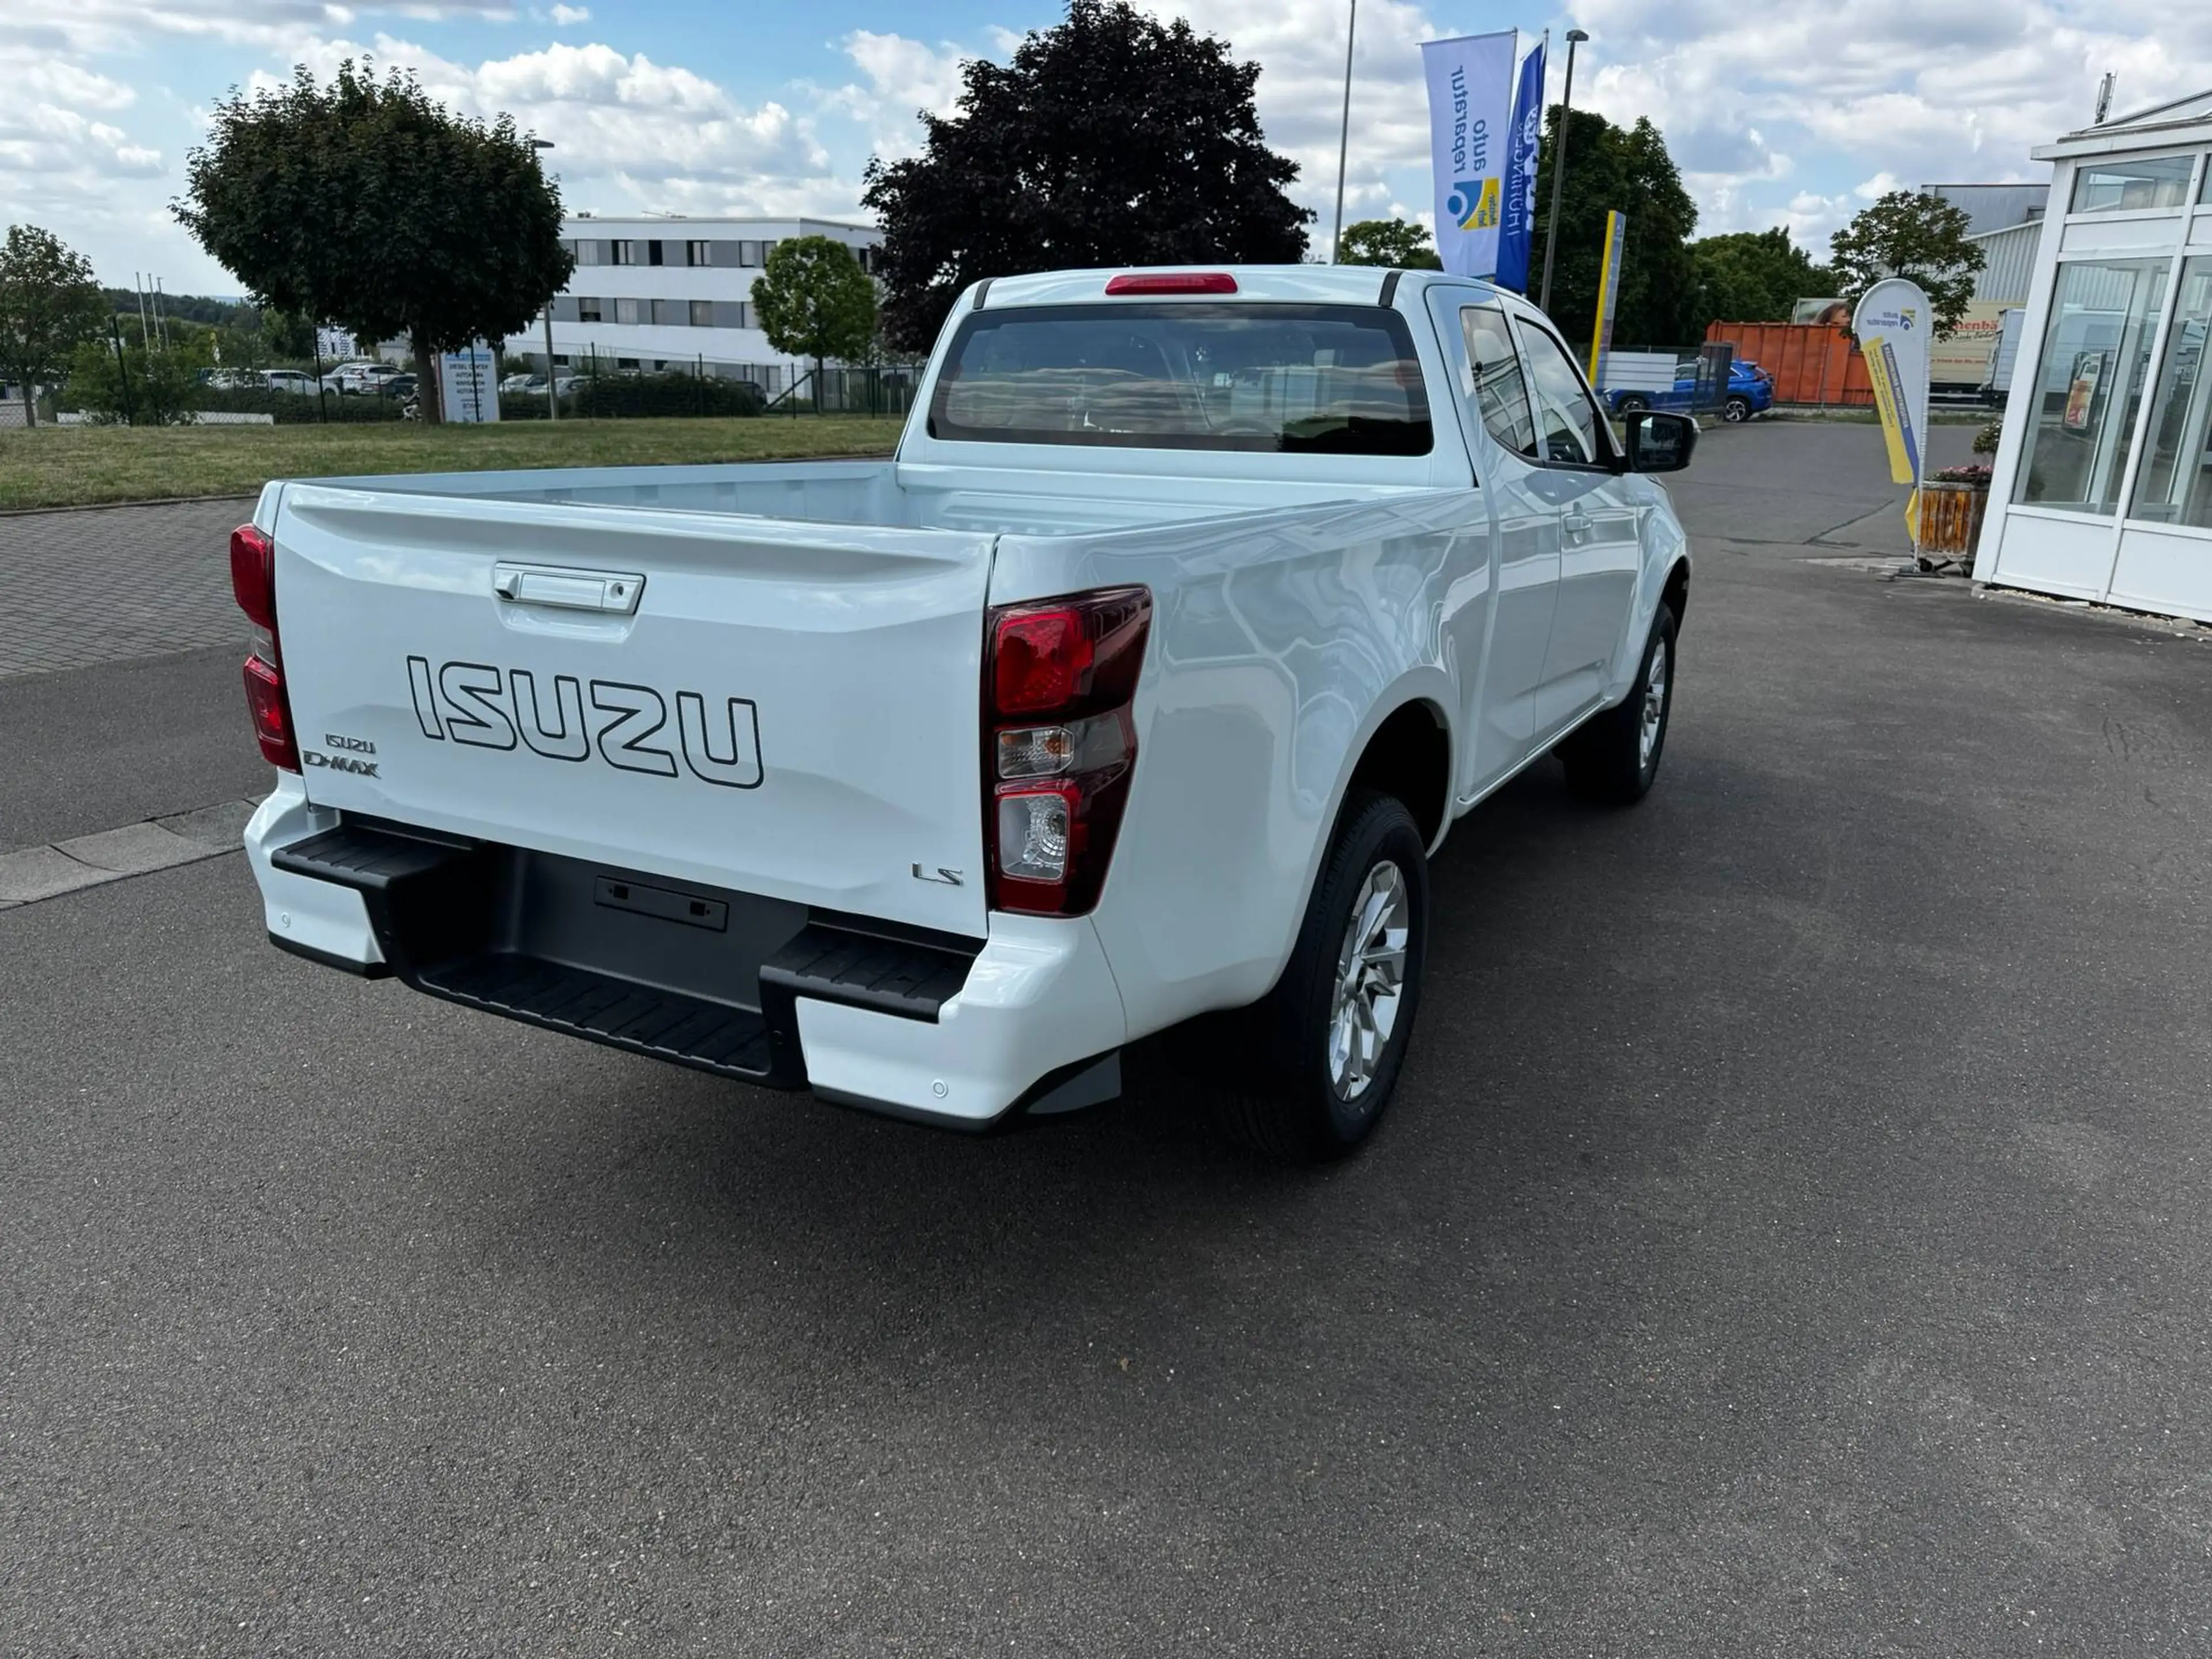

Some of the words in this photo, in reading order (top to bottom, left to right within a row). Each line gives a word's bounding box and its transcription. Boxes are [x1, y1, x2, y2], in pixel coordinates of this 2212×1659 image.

[407, 655, 764, 790] ISUZU
[325, 733, 377, 754] ISUZU
[912, 862, 964, 887] LS
